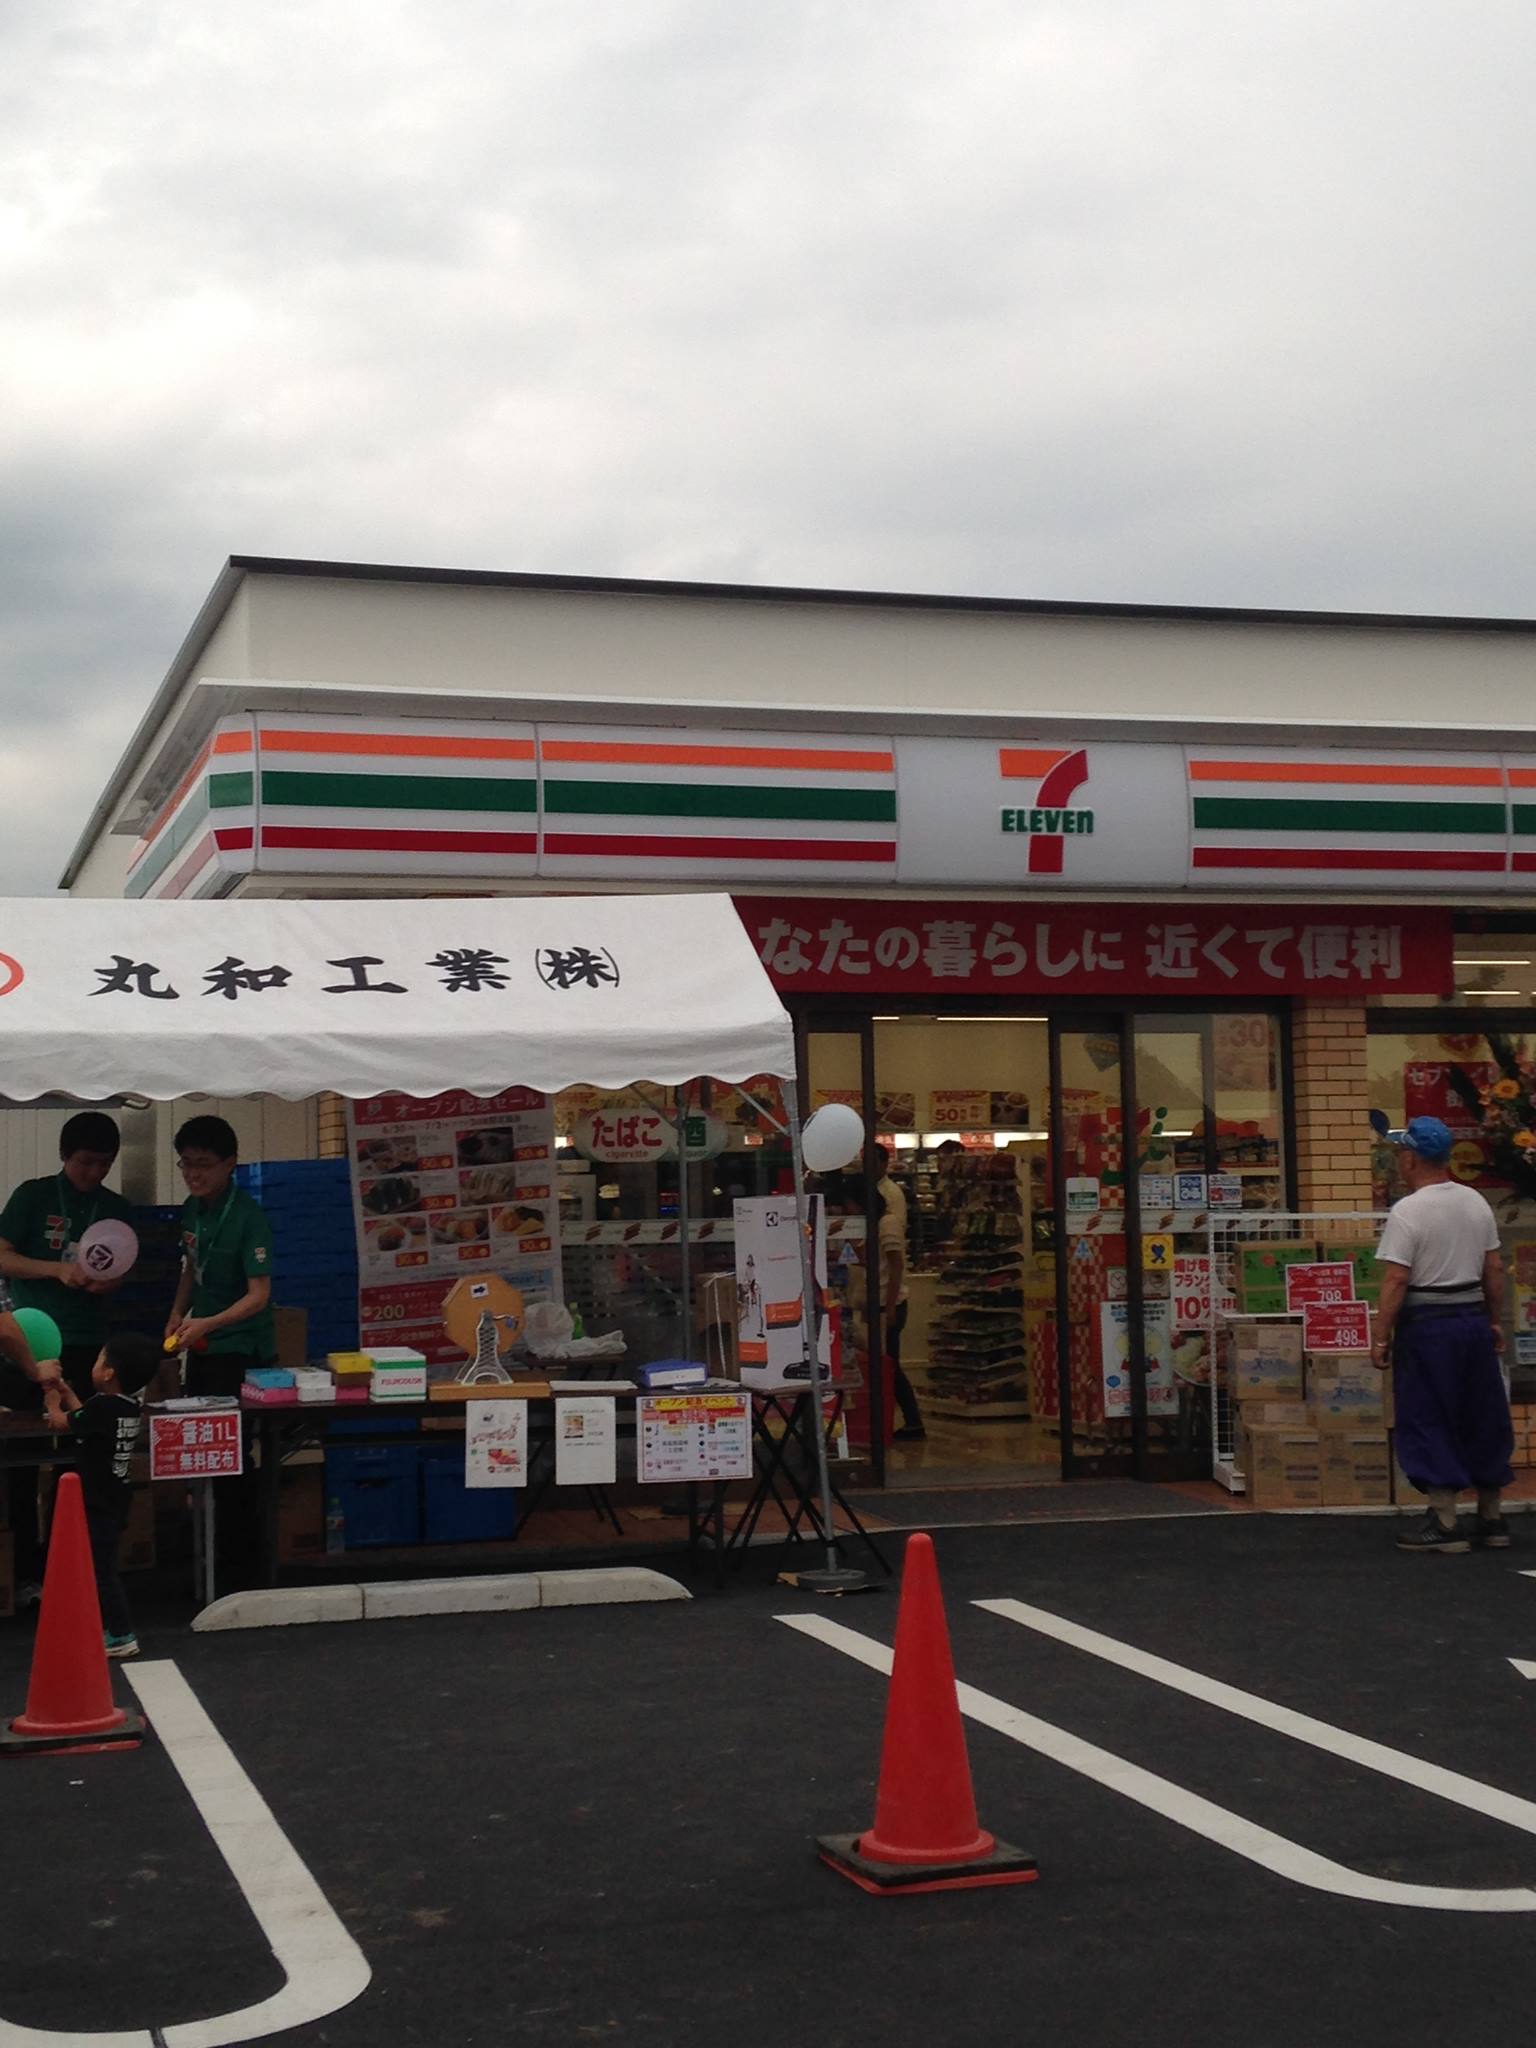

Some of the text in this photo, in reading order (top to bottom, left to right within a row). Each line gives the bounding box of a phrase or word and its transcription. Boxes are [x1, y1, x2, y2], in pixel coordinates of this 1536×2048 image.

[1000, 749, 1089, 873] 7
[1144, 922, 1402, 980] 近くて便利
[592, 1116, 663, 1147] たばこ
[373, 1304, 405, 1320] 200
[1335, 1329, 1359, 1346] 498
[180, 1449, 235, 1472] 無料配布
